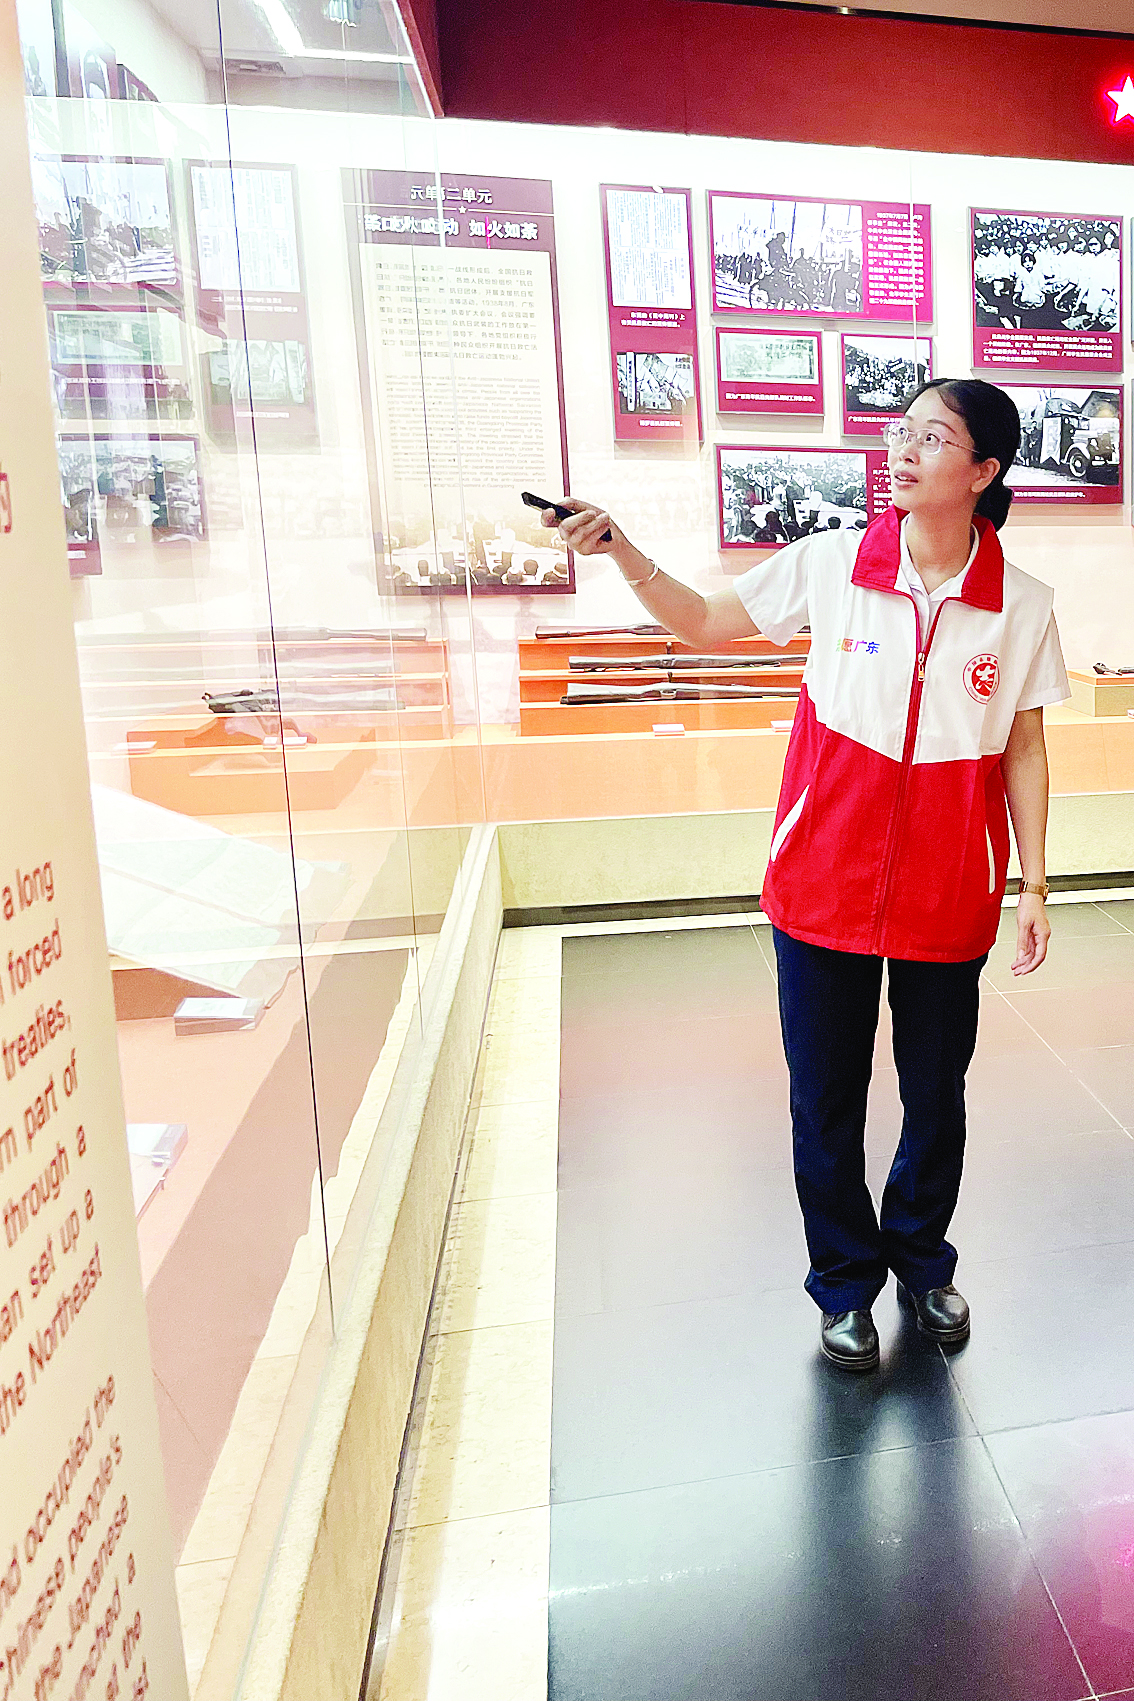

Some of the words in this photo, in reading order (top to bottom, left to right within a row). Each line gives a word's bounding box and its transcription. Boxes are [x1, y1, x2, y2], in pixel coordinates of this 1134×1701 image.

[3, 886, 15, 921] a
[15, 861, 54, 912] long
[8, 918, 62, 996] forced
[2, 999, 71, 1081] treaties,
[24, 1073, 58, 1154] part
[63, 1048, 78, 1098] of
[4, 1141, 69, 1249] through
[76, 1124, 87, 1158] a
[29, 1233, 56, 1300] set
[60, 1208, 80, 1255] up
[84, 1188, 95, 1223] a
[28, 1241, 102, 1385] Northeast
[25, 1406, 93, 1565] occupied
[94, 1374, 116, 1430] the
[68, 1434, 123, 1575] people's
[67, 1493, 129, 1651] Japanese
[127, 1552, 136, 1585] a
